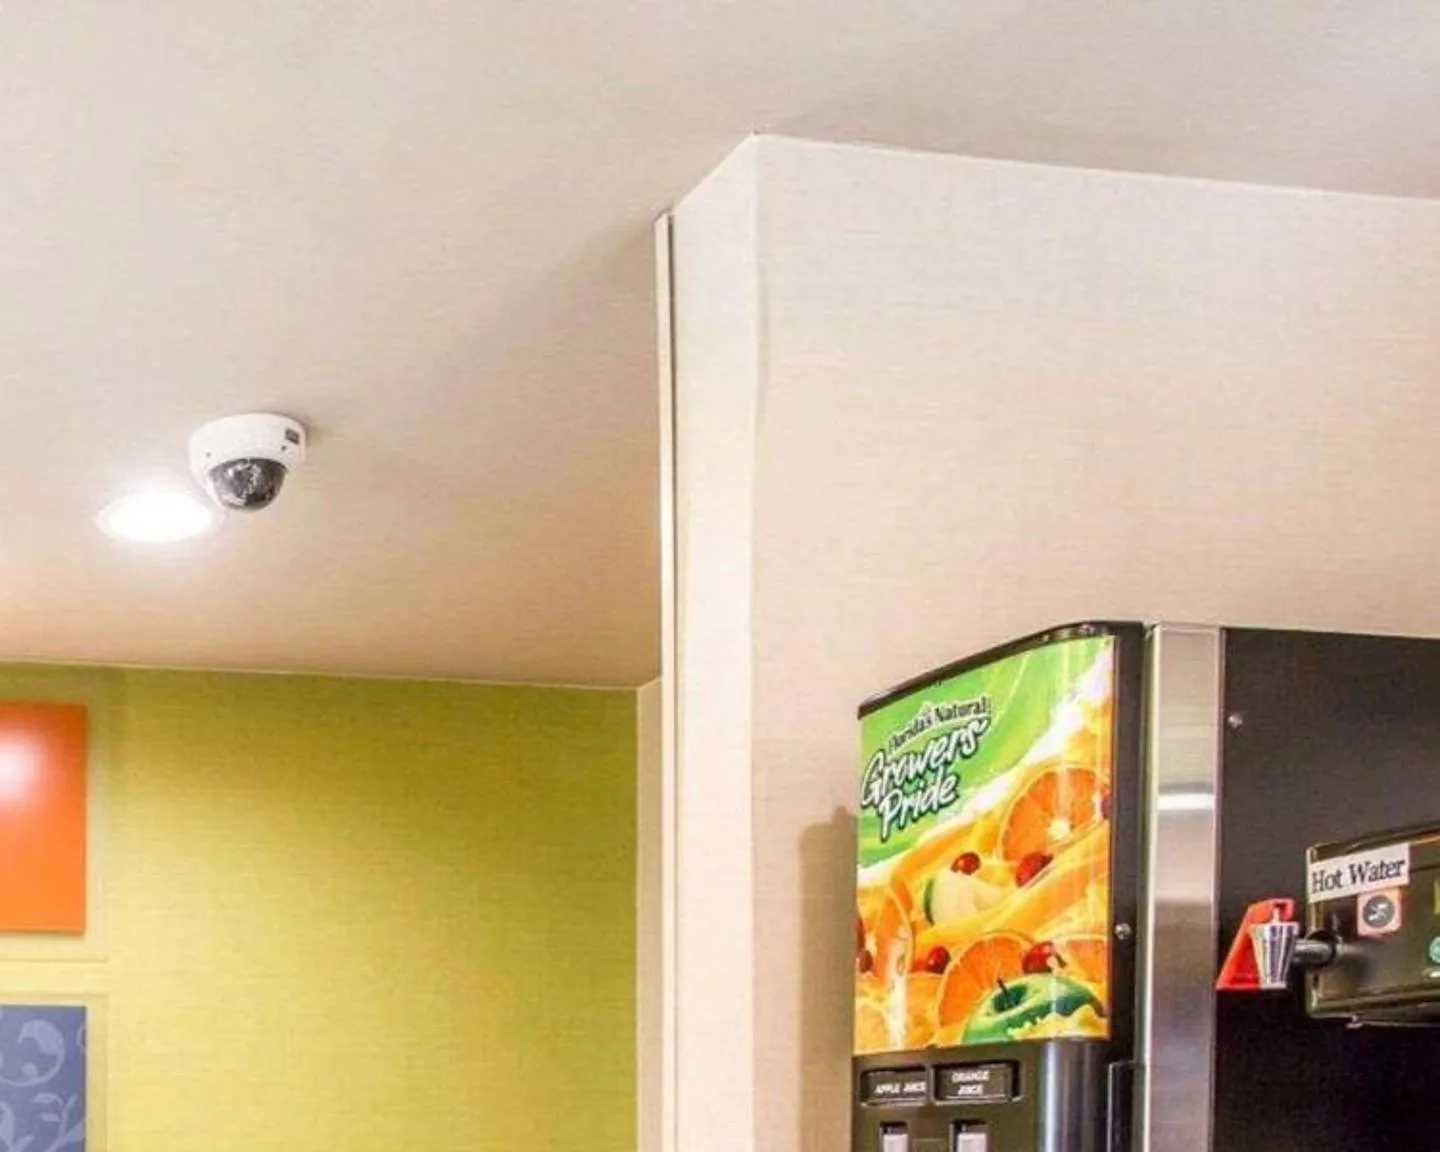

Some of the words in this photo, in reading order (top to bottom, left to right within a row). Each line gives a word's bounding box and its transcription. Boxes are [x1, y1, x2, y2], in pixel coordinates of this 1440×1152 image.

[877, 765, 960, 843] Pride
[1311, 869, 1343, 894] Hot
[1349, 858, 1406, 886] Water
